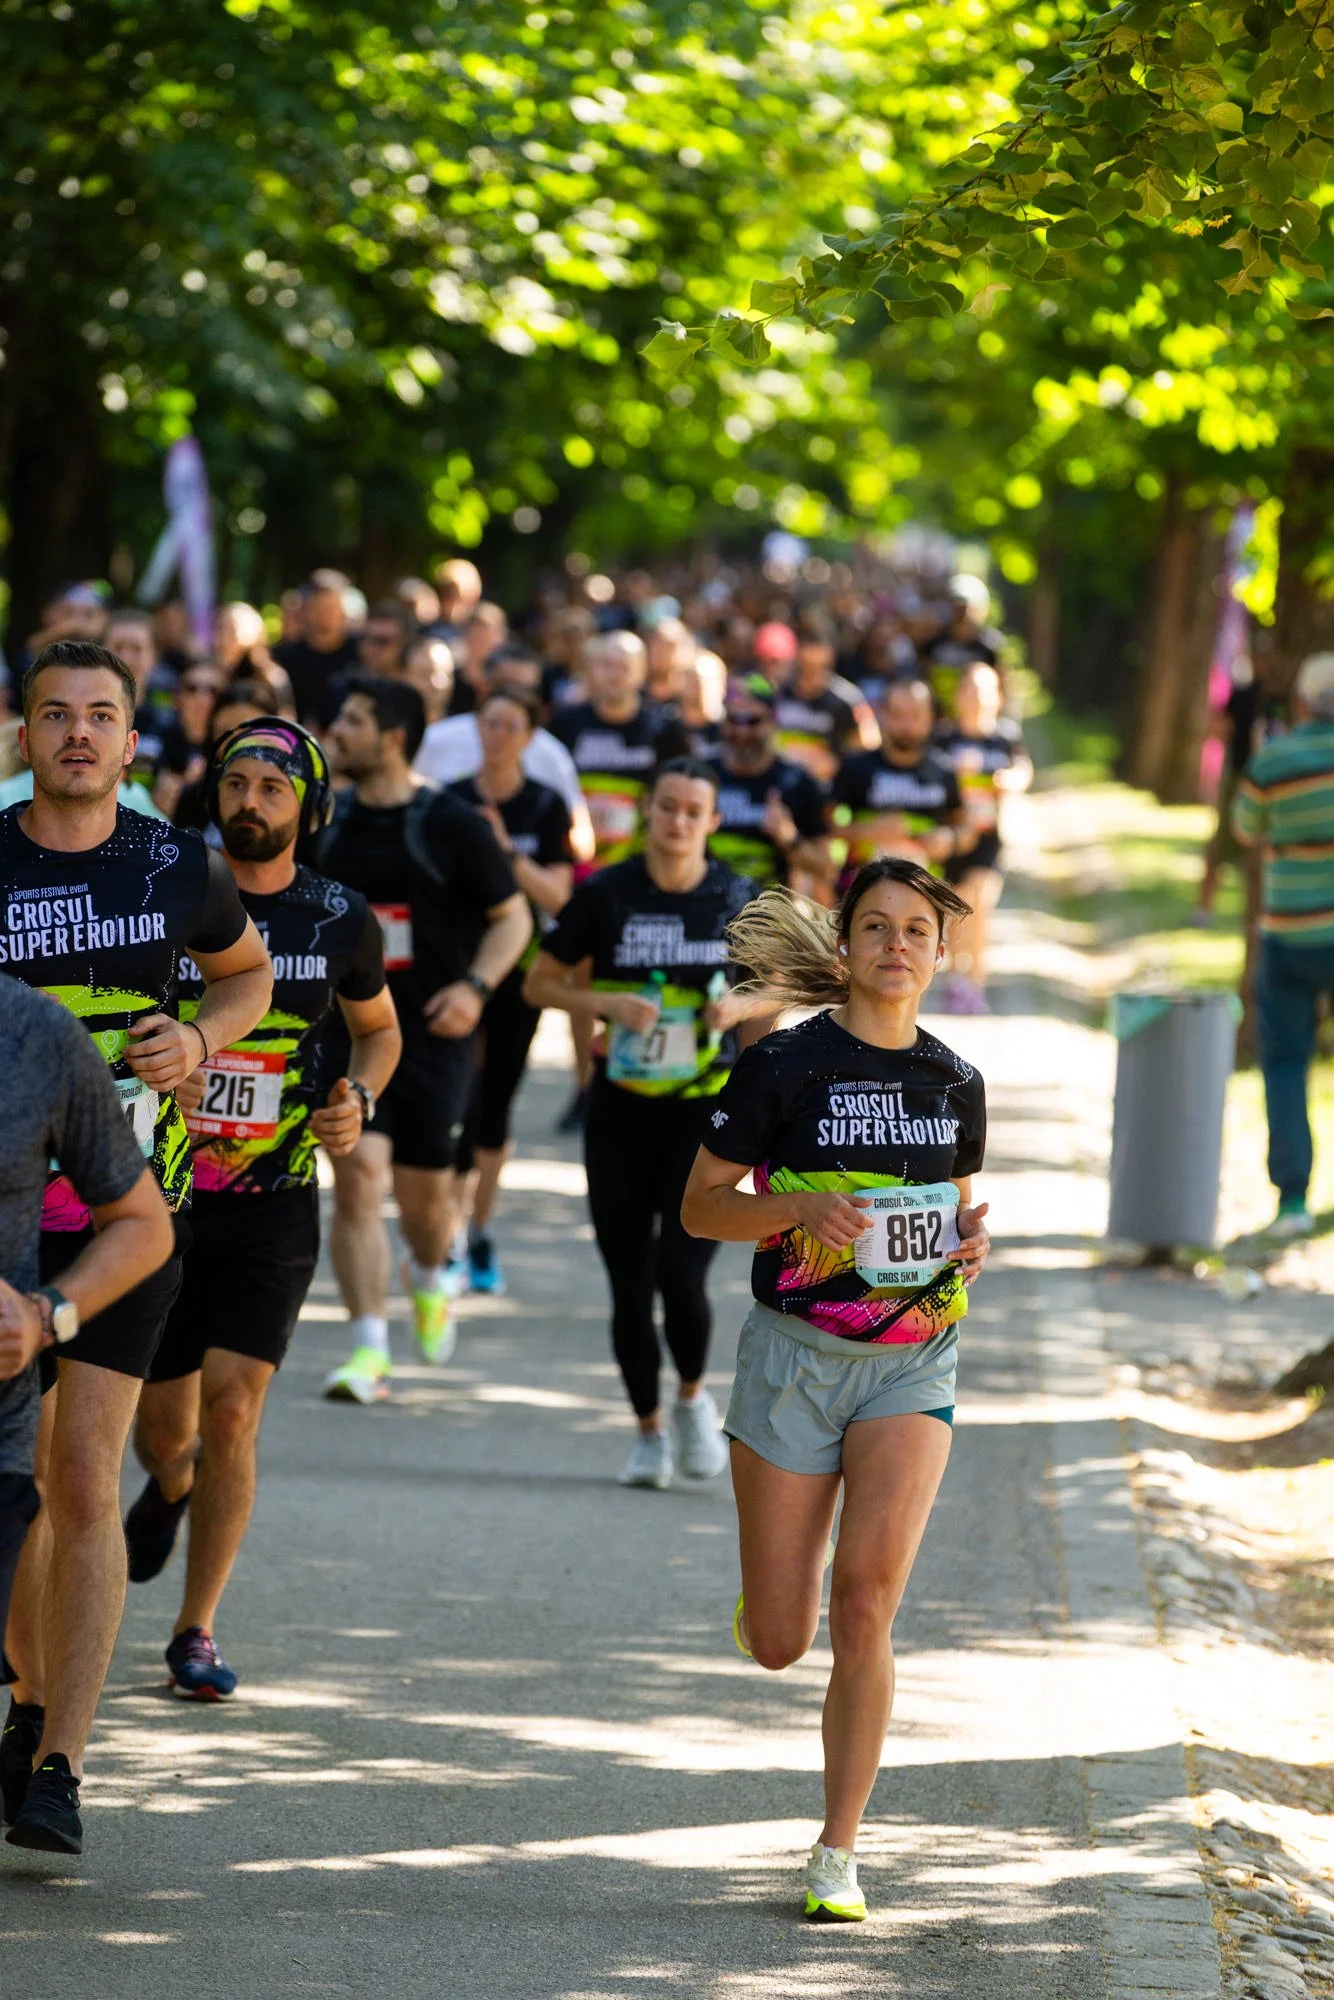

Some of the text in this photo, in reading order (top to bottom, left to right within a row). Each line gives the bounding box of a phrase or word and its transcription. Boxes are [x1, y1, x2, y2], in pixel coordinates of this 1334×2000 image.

[8, 883, 89, 902] a SPORTS FESTIVAL event
[7, 894, 99, 932] CROSUL
[828, 1081, 902, 1094] a SPORTS FESTIVAL event
[829, 1092, 909, 1119] CROSUL
[874, 1197, 903, 1209] CROSUL
[886, 1210, 943, 1263] 852
[877, 1271, 919, 1284] CROS 5KM
